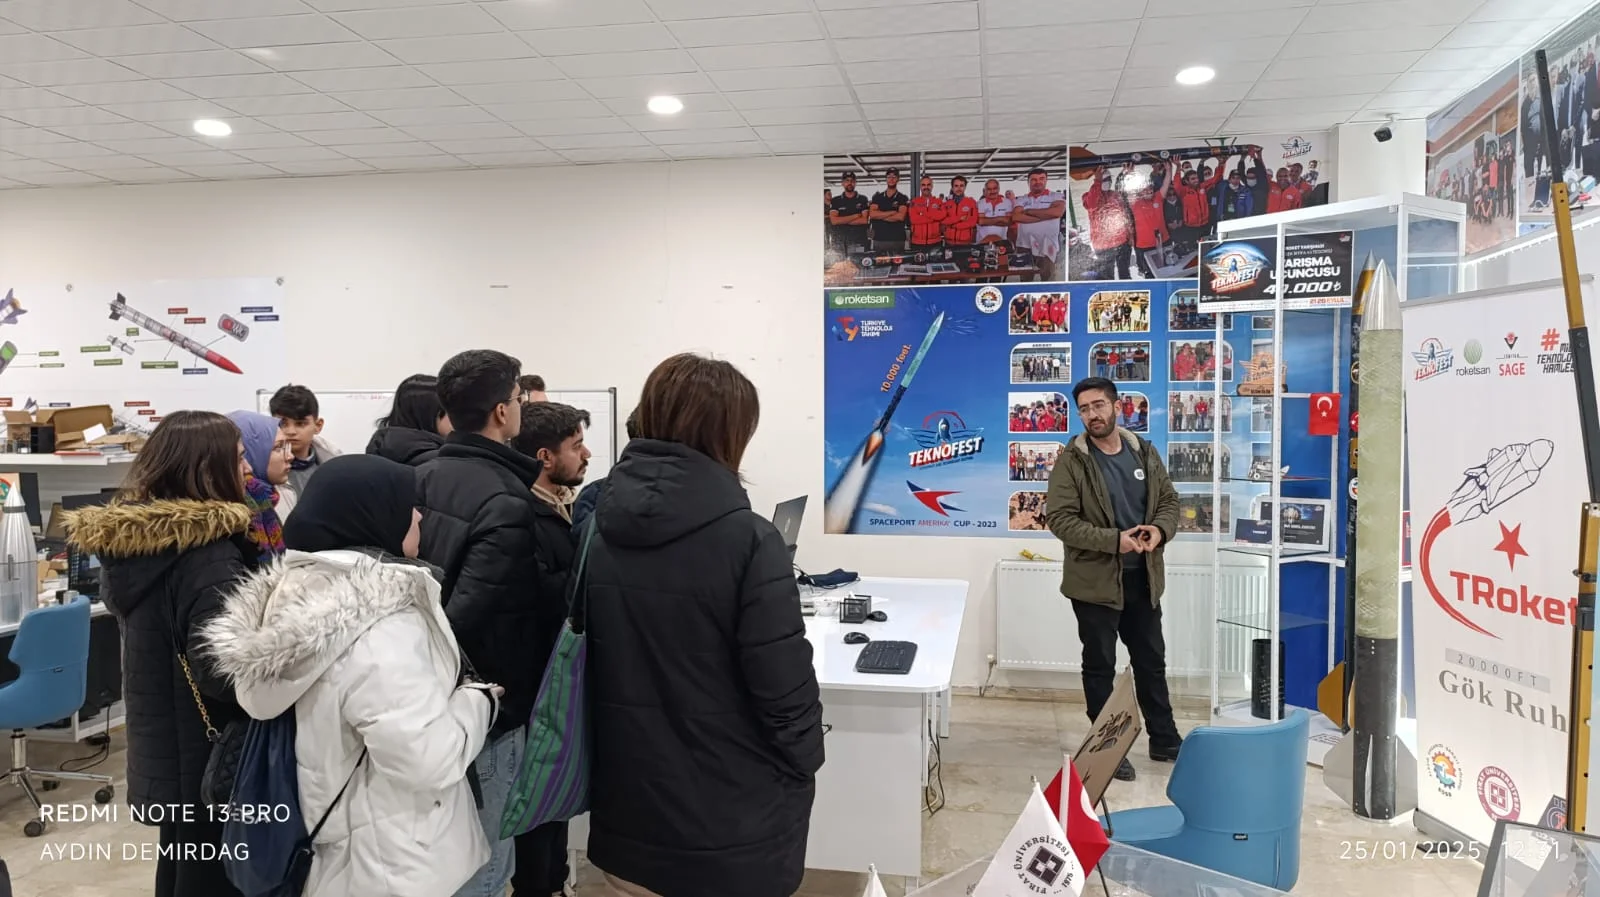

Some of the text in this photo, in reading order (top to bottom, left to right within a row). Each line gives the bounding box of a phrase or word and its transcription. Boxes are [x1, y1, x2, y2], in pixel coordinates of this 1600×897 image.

[1211, 268, 1258, 289] TEKNOFEST
[845, 294, 889, 305] roketsan
[1456, 366, 1491, 377] roketsan
[1499, 362, 1526, 377] SAGE
[908, 436, 984, 468] TEKNOFEST
[870, 518, 916, 526] SPACEPORT
[977, 520, 997, 528] 2023
[1449, 570, 1578, 626] TRoket
[1438, 669, 1494, 707] Gök
[1018, 872, 1047, 894] FIRAT
[1061, 872, 1074, 888] 1975
